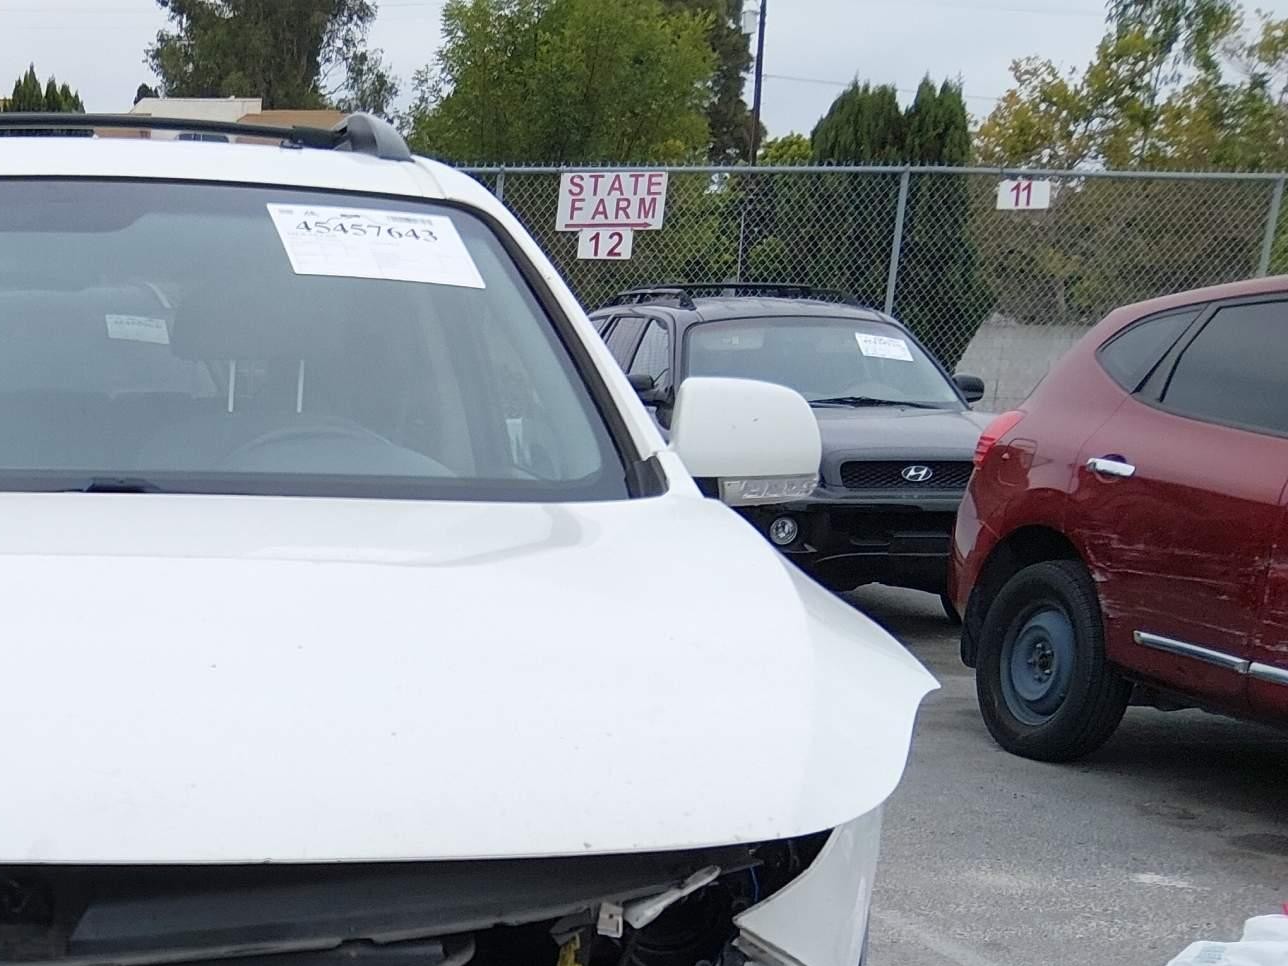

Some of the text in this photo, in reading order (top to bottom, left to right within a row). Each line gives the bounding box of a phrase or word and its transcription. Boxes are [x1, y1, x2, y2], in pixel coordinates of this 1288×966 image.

[568, 173, 663, 197] STATE
[1010, 182, 1032, 207] 11
[569, 197, 657, 220] FARM
[295, 220, 438, 242] 45457643
[589, 231, 623, 257] 12
